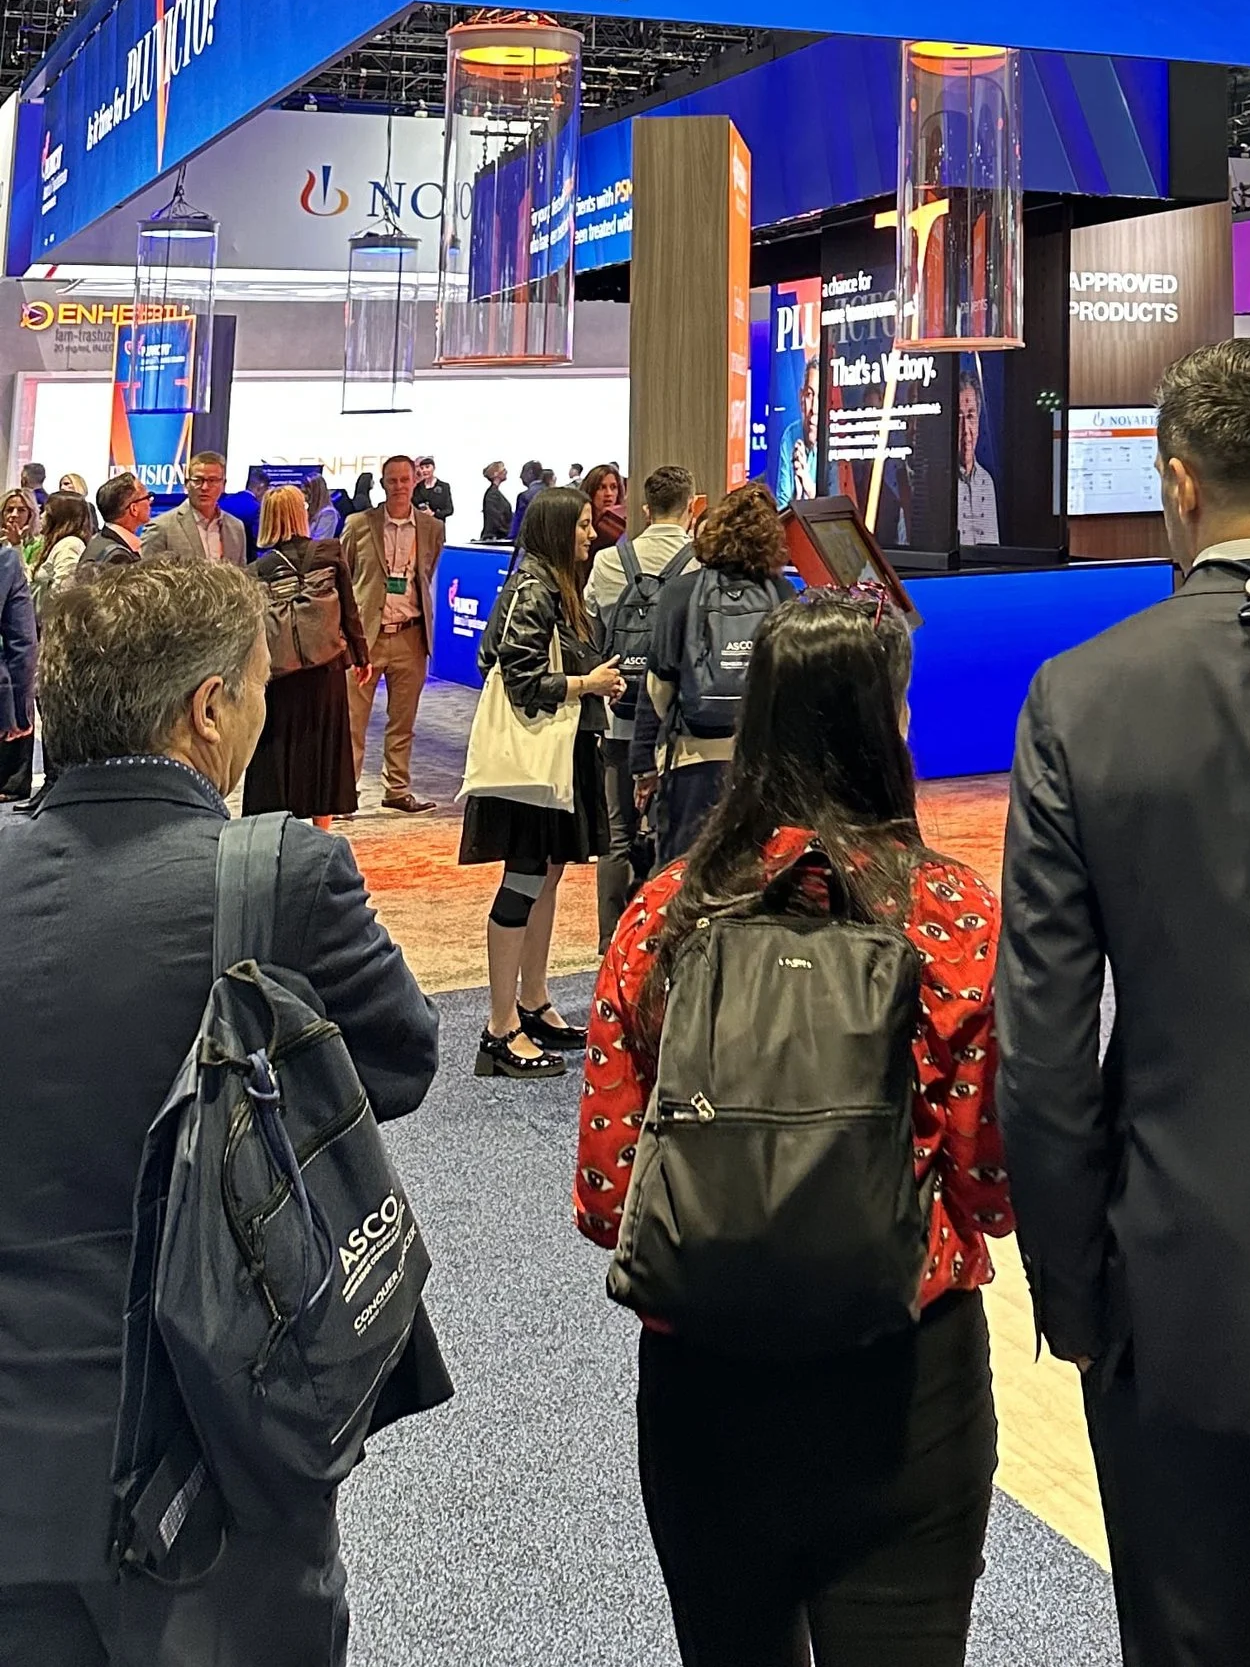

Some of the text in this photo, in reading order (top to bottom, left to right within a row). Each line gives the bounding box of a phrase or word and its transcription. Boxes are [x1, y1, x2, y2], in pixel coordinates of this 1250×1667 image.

[1069, 271, 1178, 294] APPROVED
[1069, 301, 1178, 323] PRODUCTS
[55, 329, 115, 343] fam-trastuz
[1110, 416, 1157, 426] NOVART
[726, 641, 753, 651] ASCO
[339, 1195, 398, 1275] ASCO
[353, 1269, 399, 1330] CONQUER
